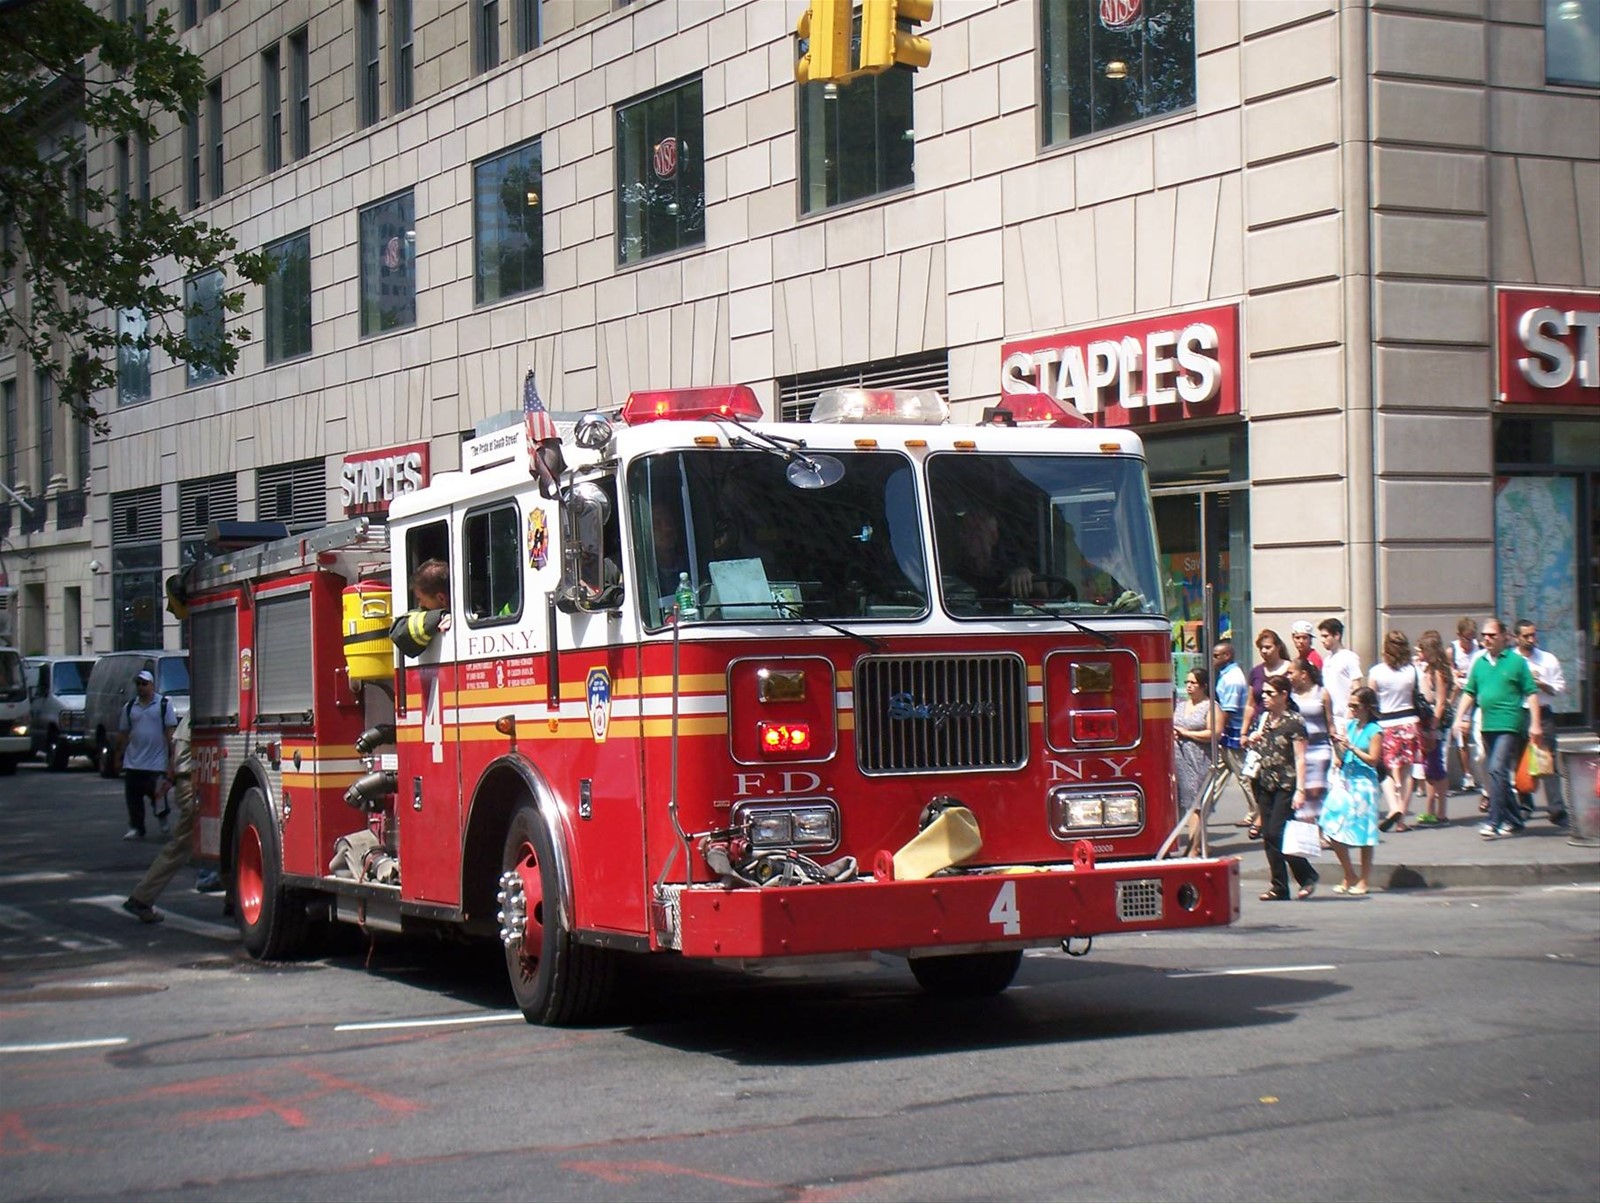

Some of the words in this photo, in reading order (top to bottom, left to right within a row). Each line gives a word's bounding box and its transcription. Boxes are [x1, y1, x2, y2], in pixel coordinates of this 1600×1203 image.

[1001, 322, 1222, 414] STAPLES
[1518, 305, 1600, 389] ST
[341, 452, 423, 507] STAPLES
[468, 630, 537, 656] F.D.N.Y.
[424, 677, 443, 764] 4
[733, 771, 834, 795] F.D.
[1046, 756, 1142, 780] N.Y.
[989, 880, 1021, 936] 4
